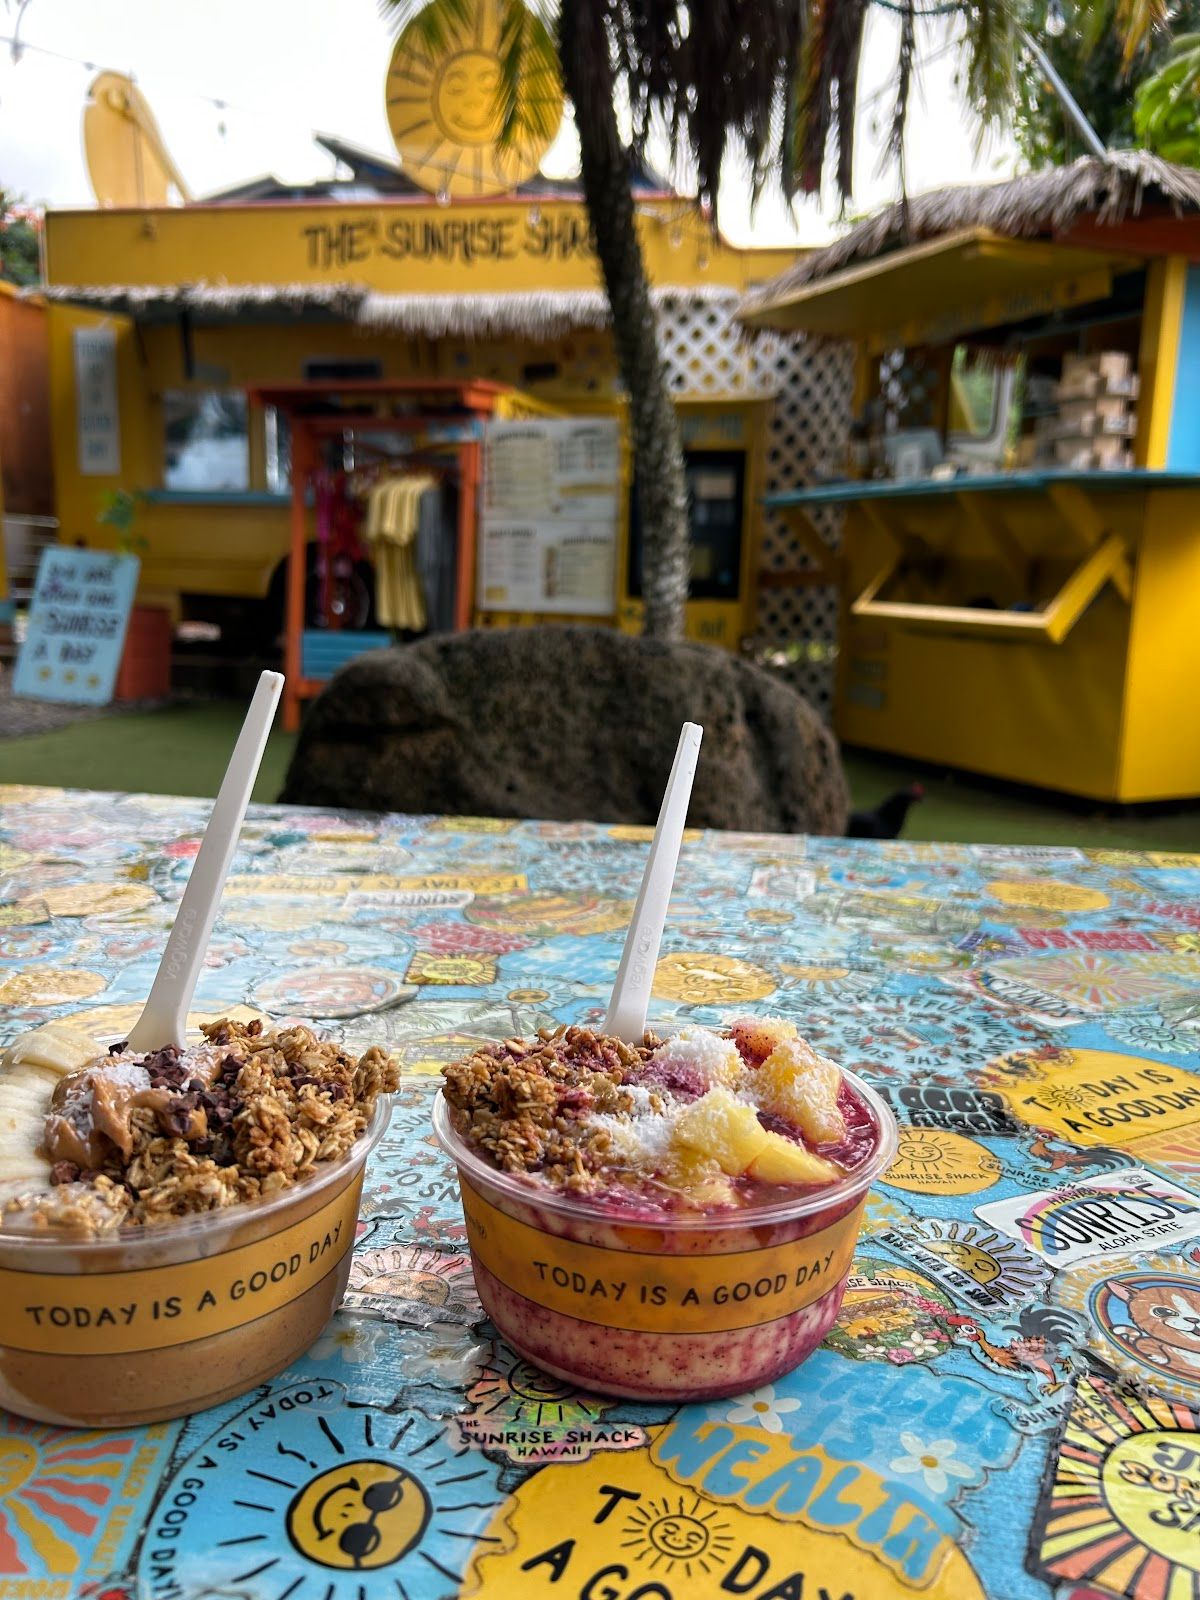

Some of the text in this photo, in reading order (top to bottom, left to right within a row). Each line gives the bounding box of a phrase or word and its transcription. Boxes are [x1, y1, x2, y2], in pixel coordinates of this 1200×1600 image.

[305, 218, 370, 269] THE
[382, 215, 518, 266] SUNRISE
[904, 1054, 949, 1066] THE
[1135, 1068, 1174, 1085] IS
[1062, 1085, 1200, 1134] A GOOD DAY
[375, 1137, 405, 1163] THE
[885, 1172, 989, 1180] SUNRISE SHACK
[986, 1163, 1050, 1184] SUNRISE
[1014, 1182, 1200, 1252] SUNRISE
[1099, 1220, 1184, 1251] ALOHA STATE
[25, 1219, 344, 1329] TODAY IS A GOOD DAY
[532, 1249, 835, 1307] TODAY IS A GOOD DAY
[870, 1277, 914, 1289] SHACK
[965, 1287, 998, 1306] SUN
[248, 1385, 334, 1431] TODAY
[460, 1420, 481, 1429] THE
[217, 1431, 246, 1452] IS
[459, 1429, 640, 1446] SUNRISE SHACK
[197, 1455, 219, 1469] A
[517, 1445, 582, 1457] HAWAII
[658, 1402, 942, 1580] WEALTH
[156, 1477, 205, 1540] GOOD
[521, 1538, 576, 1583] A
